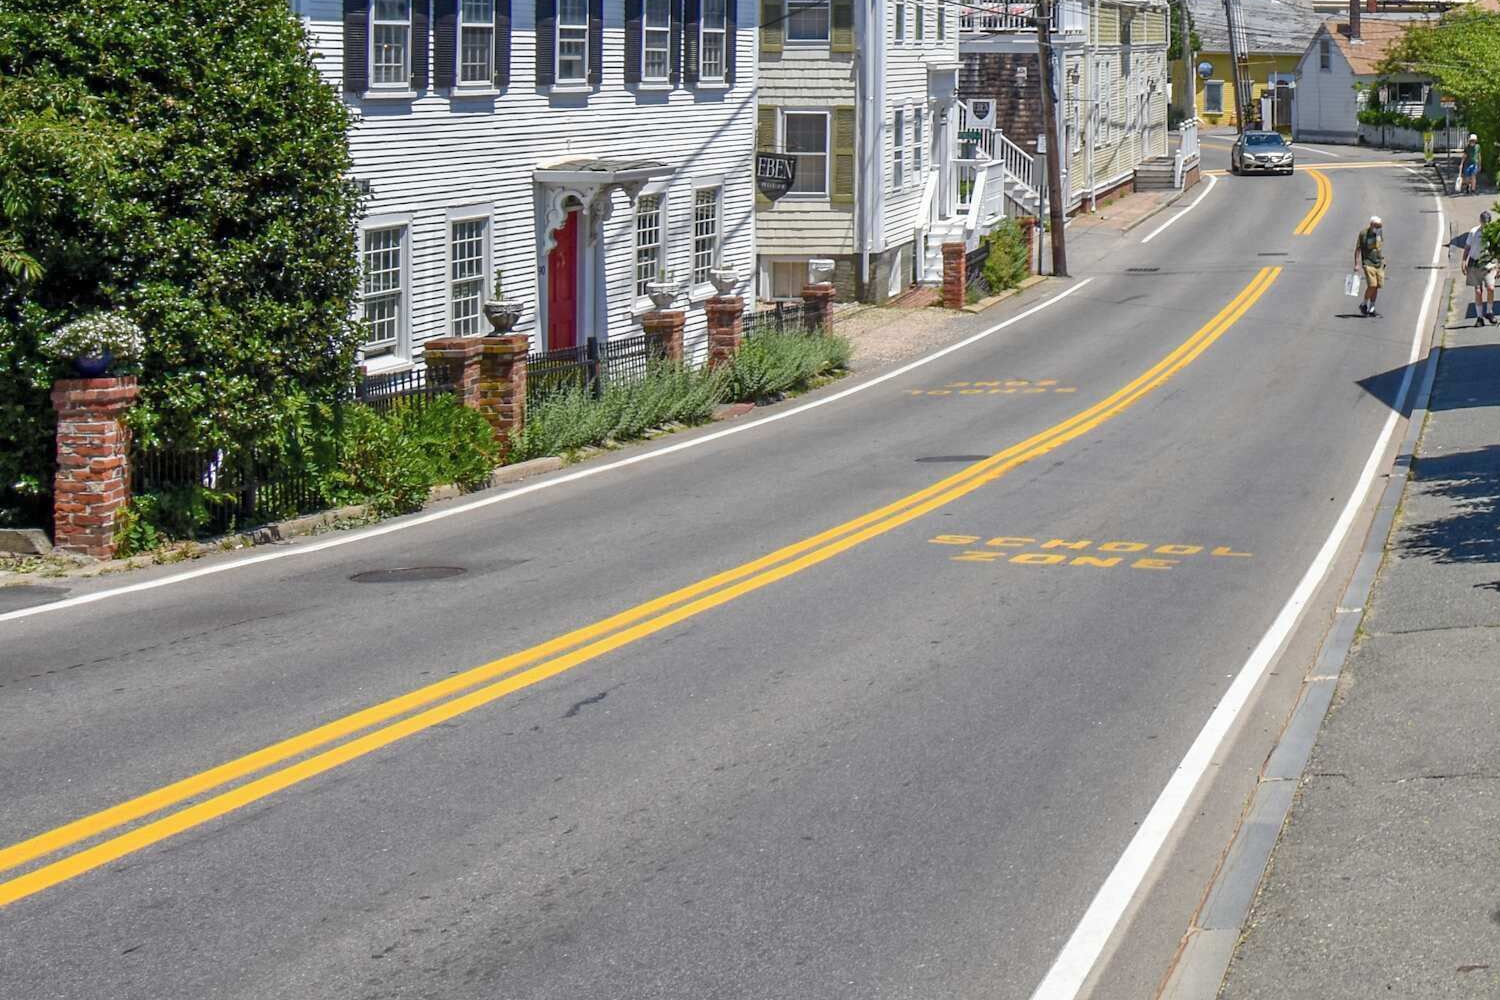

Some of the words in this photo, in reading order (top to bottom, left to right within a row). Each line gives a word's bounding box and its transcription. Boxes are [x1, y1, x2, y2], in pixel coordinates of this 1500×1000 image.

[757, 156, 794, 180] EBEN
[928, 534, 1253, 558] SCHOOL
[949, 550, 1184, 570] ZONE
